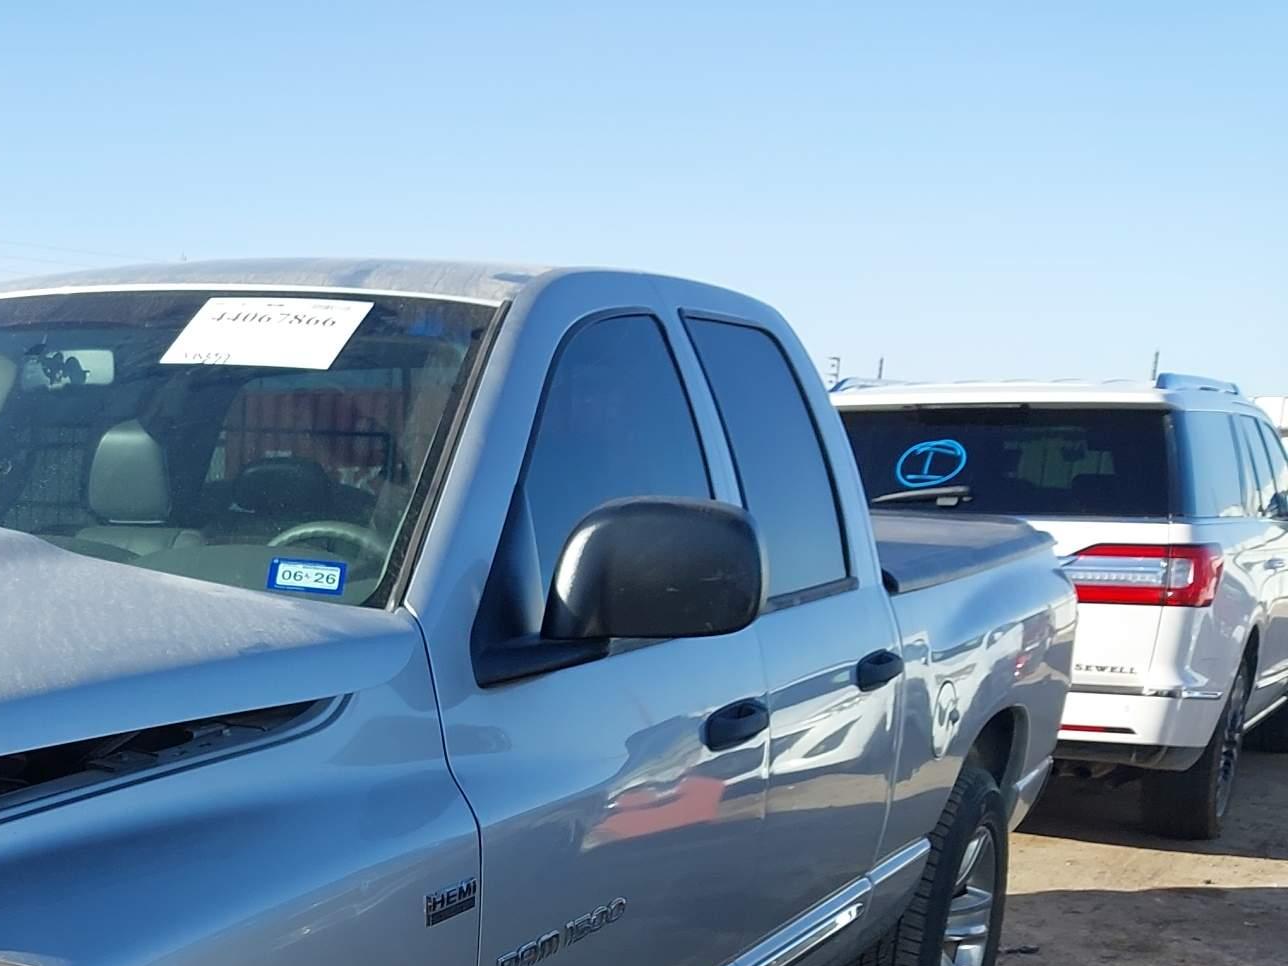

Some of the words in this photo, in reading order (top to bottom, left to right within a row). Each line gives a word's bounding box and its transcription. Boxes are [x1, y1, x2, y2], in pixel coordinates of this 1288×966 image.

[212, 310, 337, 328] 44067866
[281, 570, 305, 582] 06
[313, 572, 338, 585] 26
[1074, 663, 1138, 675] SEWELL
[431, 879, 477, 912] HEMI
[565, 896, 627, 946] 1500
